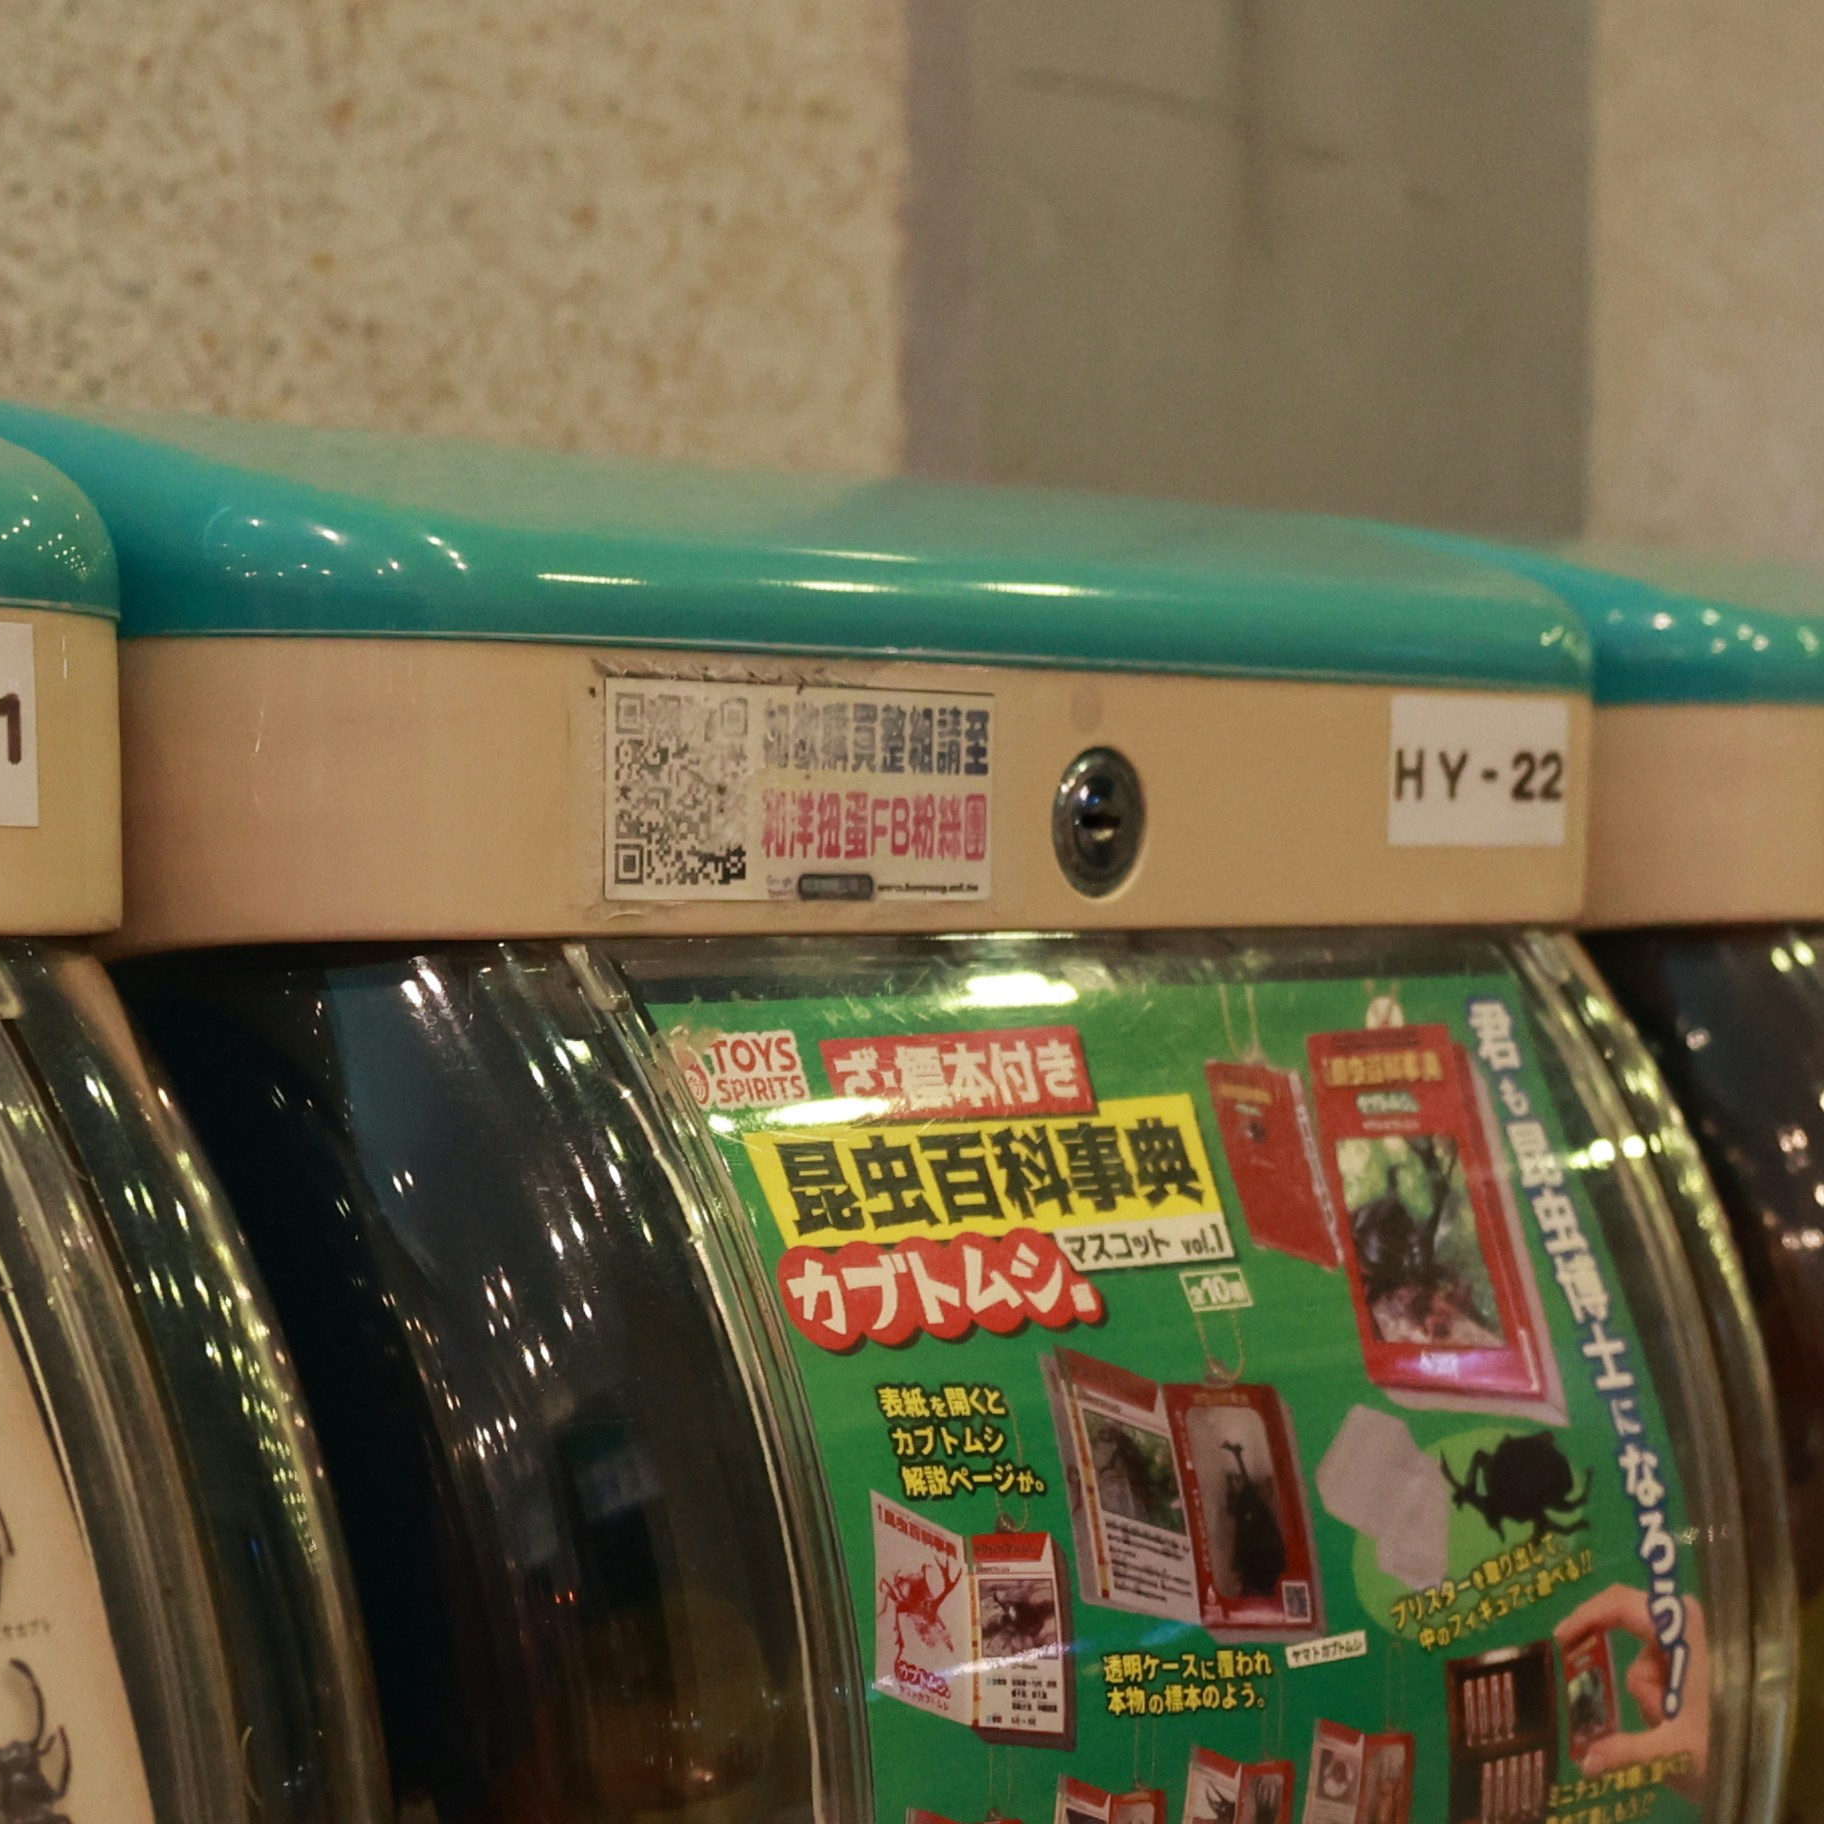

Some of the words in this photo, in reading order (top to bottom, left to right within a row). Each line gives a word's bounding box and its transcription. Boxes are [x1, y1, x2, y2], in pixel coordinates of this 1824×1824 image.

[760, 788, 989, 862] 和洋扭蛋FB粉絲團
[711, 1036, 797, 1074] TOYS
[715, 1074, 805, 1104] SPIRITS
[774, 1116, 1205, 1236] 昆虫百科事典
[1064, 1227, 1171, 1264] マスコット
[1181, 1223, 1225, 1257] vol.1
[878, 1386, 1007, 1419] 表紙を開くと
[891, 1426, 1005, 1457] カブトムシ
[902, 1464, 1047, 1499] 解説ページが。
[1103, 1649, 1273, 1684] 透明ケースに覆われ
[1106, 1683, 1266, 1717] 本物の標本のよう。
